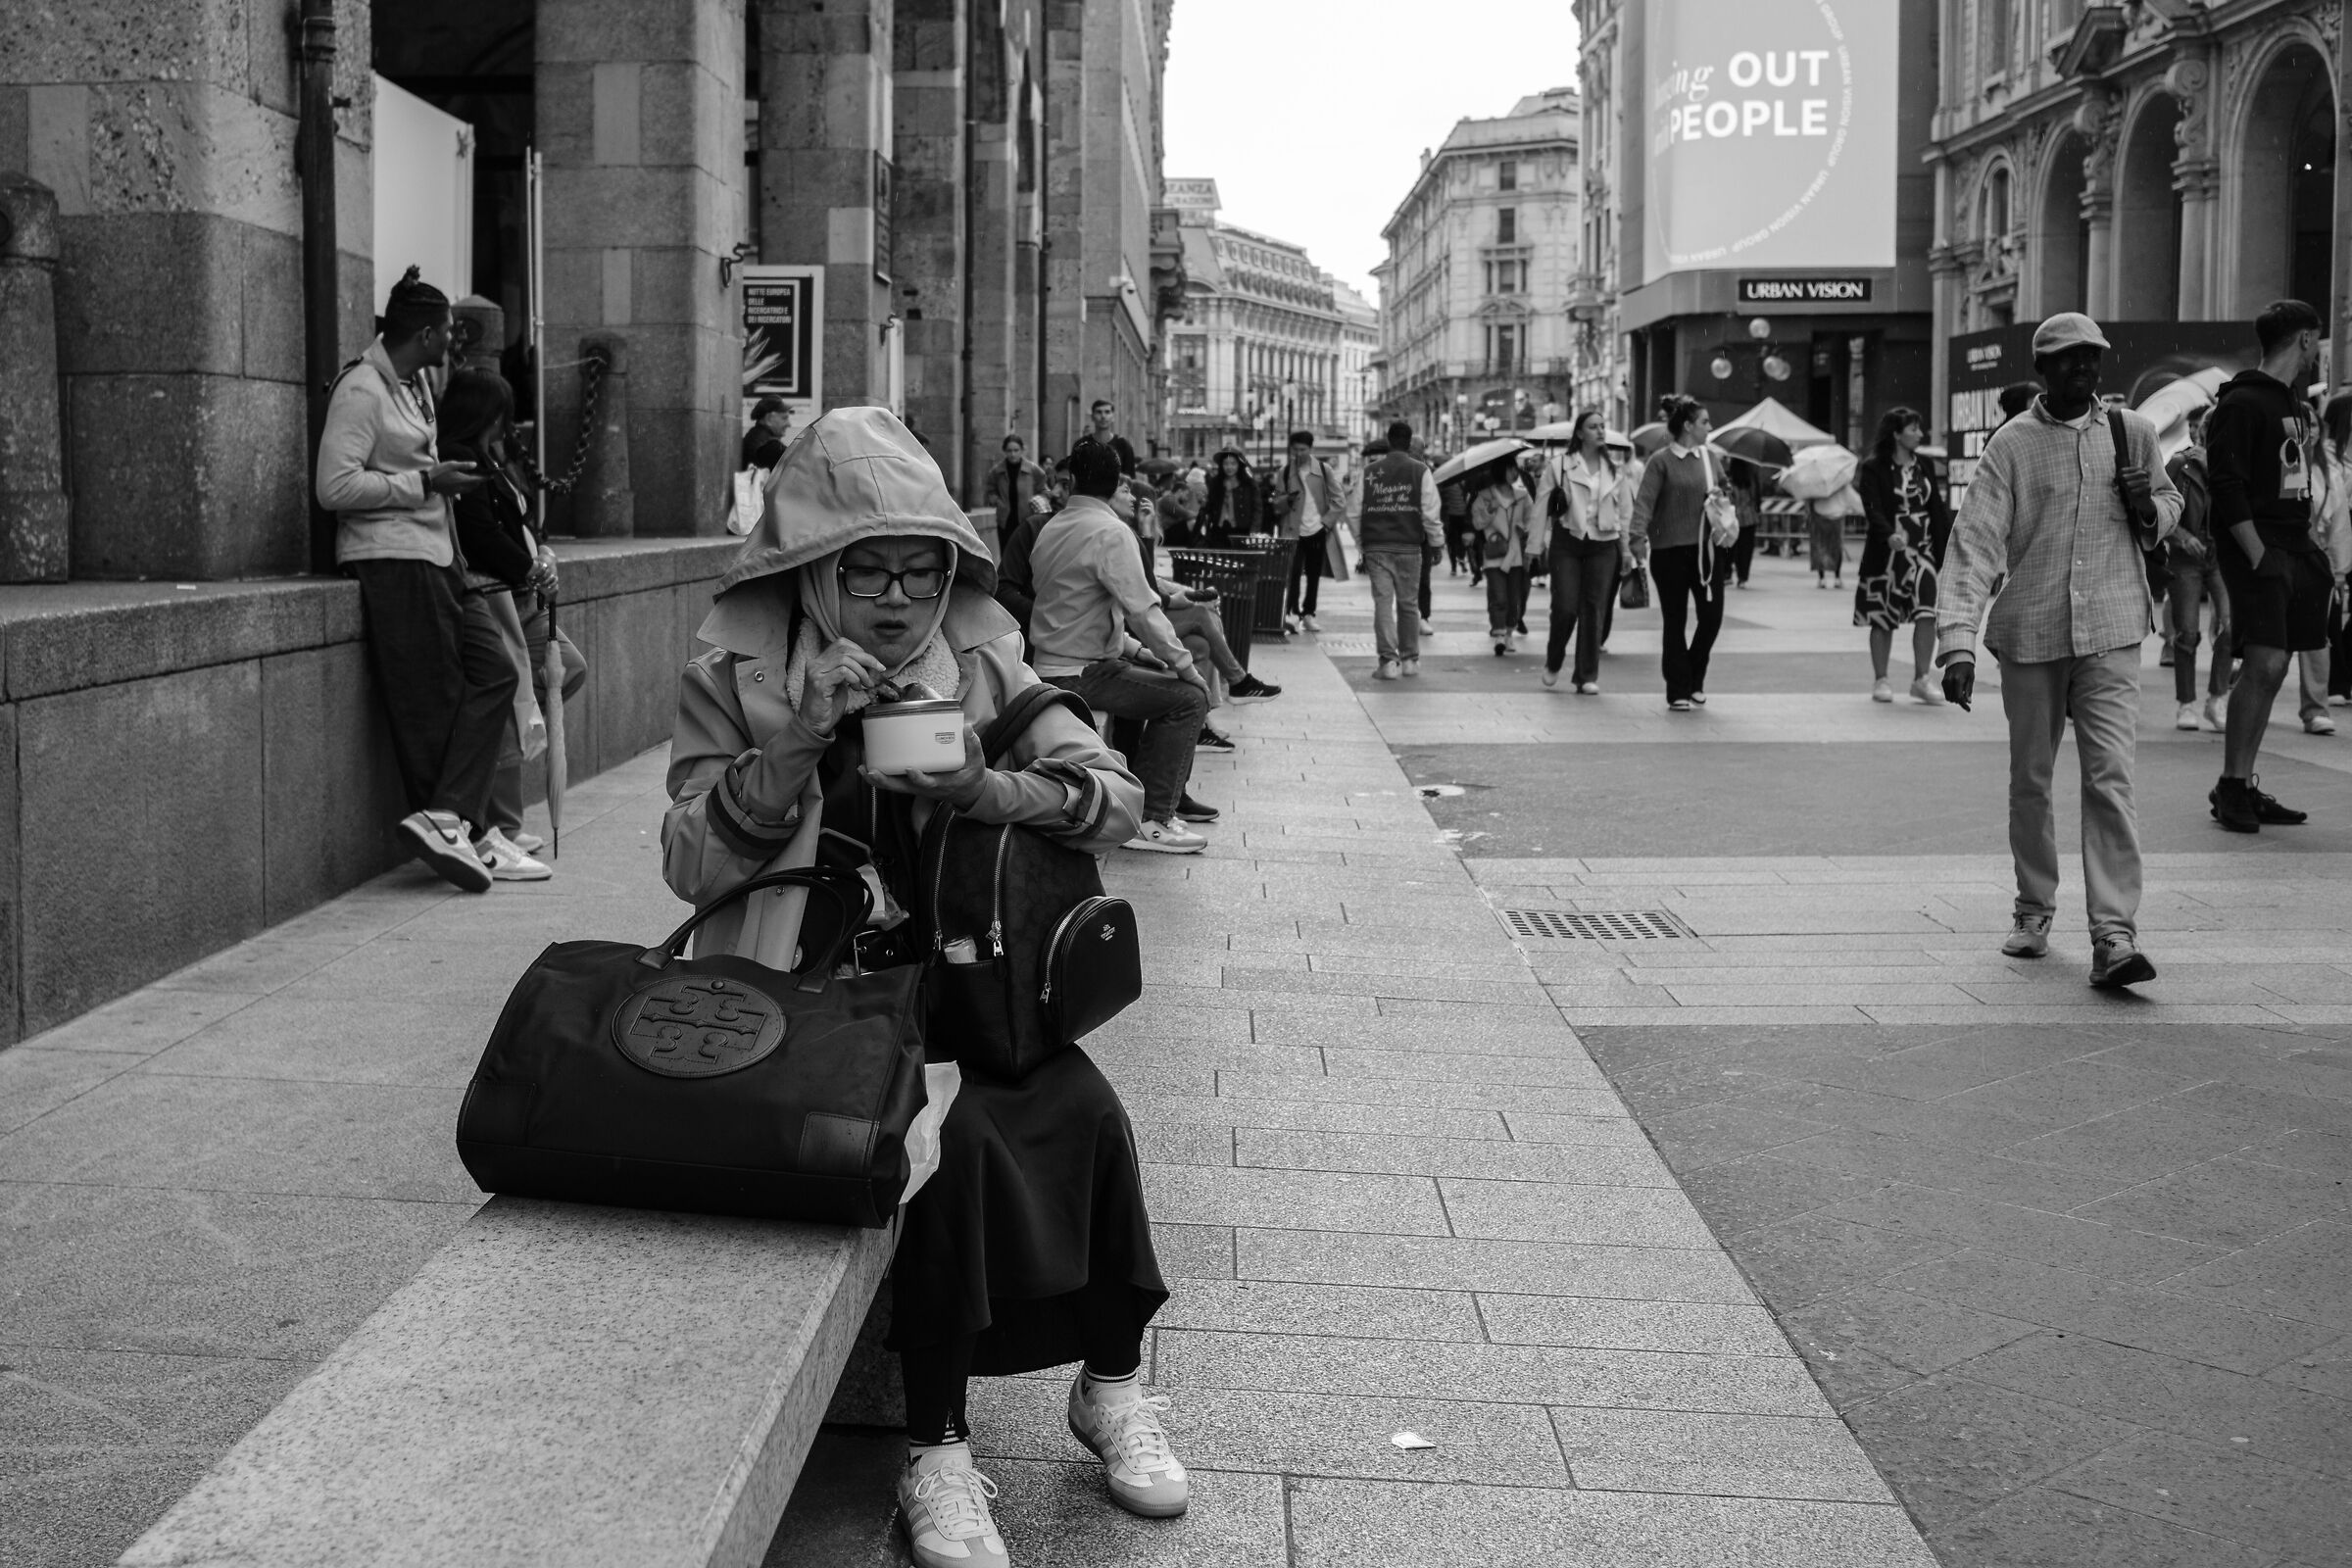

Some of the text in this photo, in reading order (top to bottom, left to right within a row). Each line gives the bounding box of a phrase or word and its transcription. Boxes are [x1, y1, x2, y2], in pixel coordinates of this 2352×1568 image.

[1728, 50, 1830, 88] OUT
[1670, 99, 1828, 145] PEOPLE
[1746, 281, 1864, 299] URBAN VISION
[1373, 482, 1413, 496] Messing
